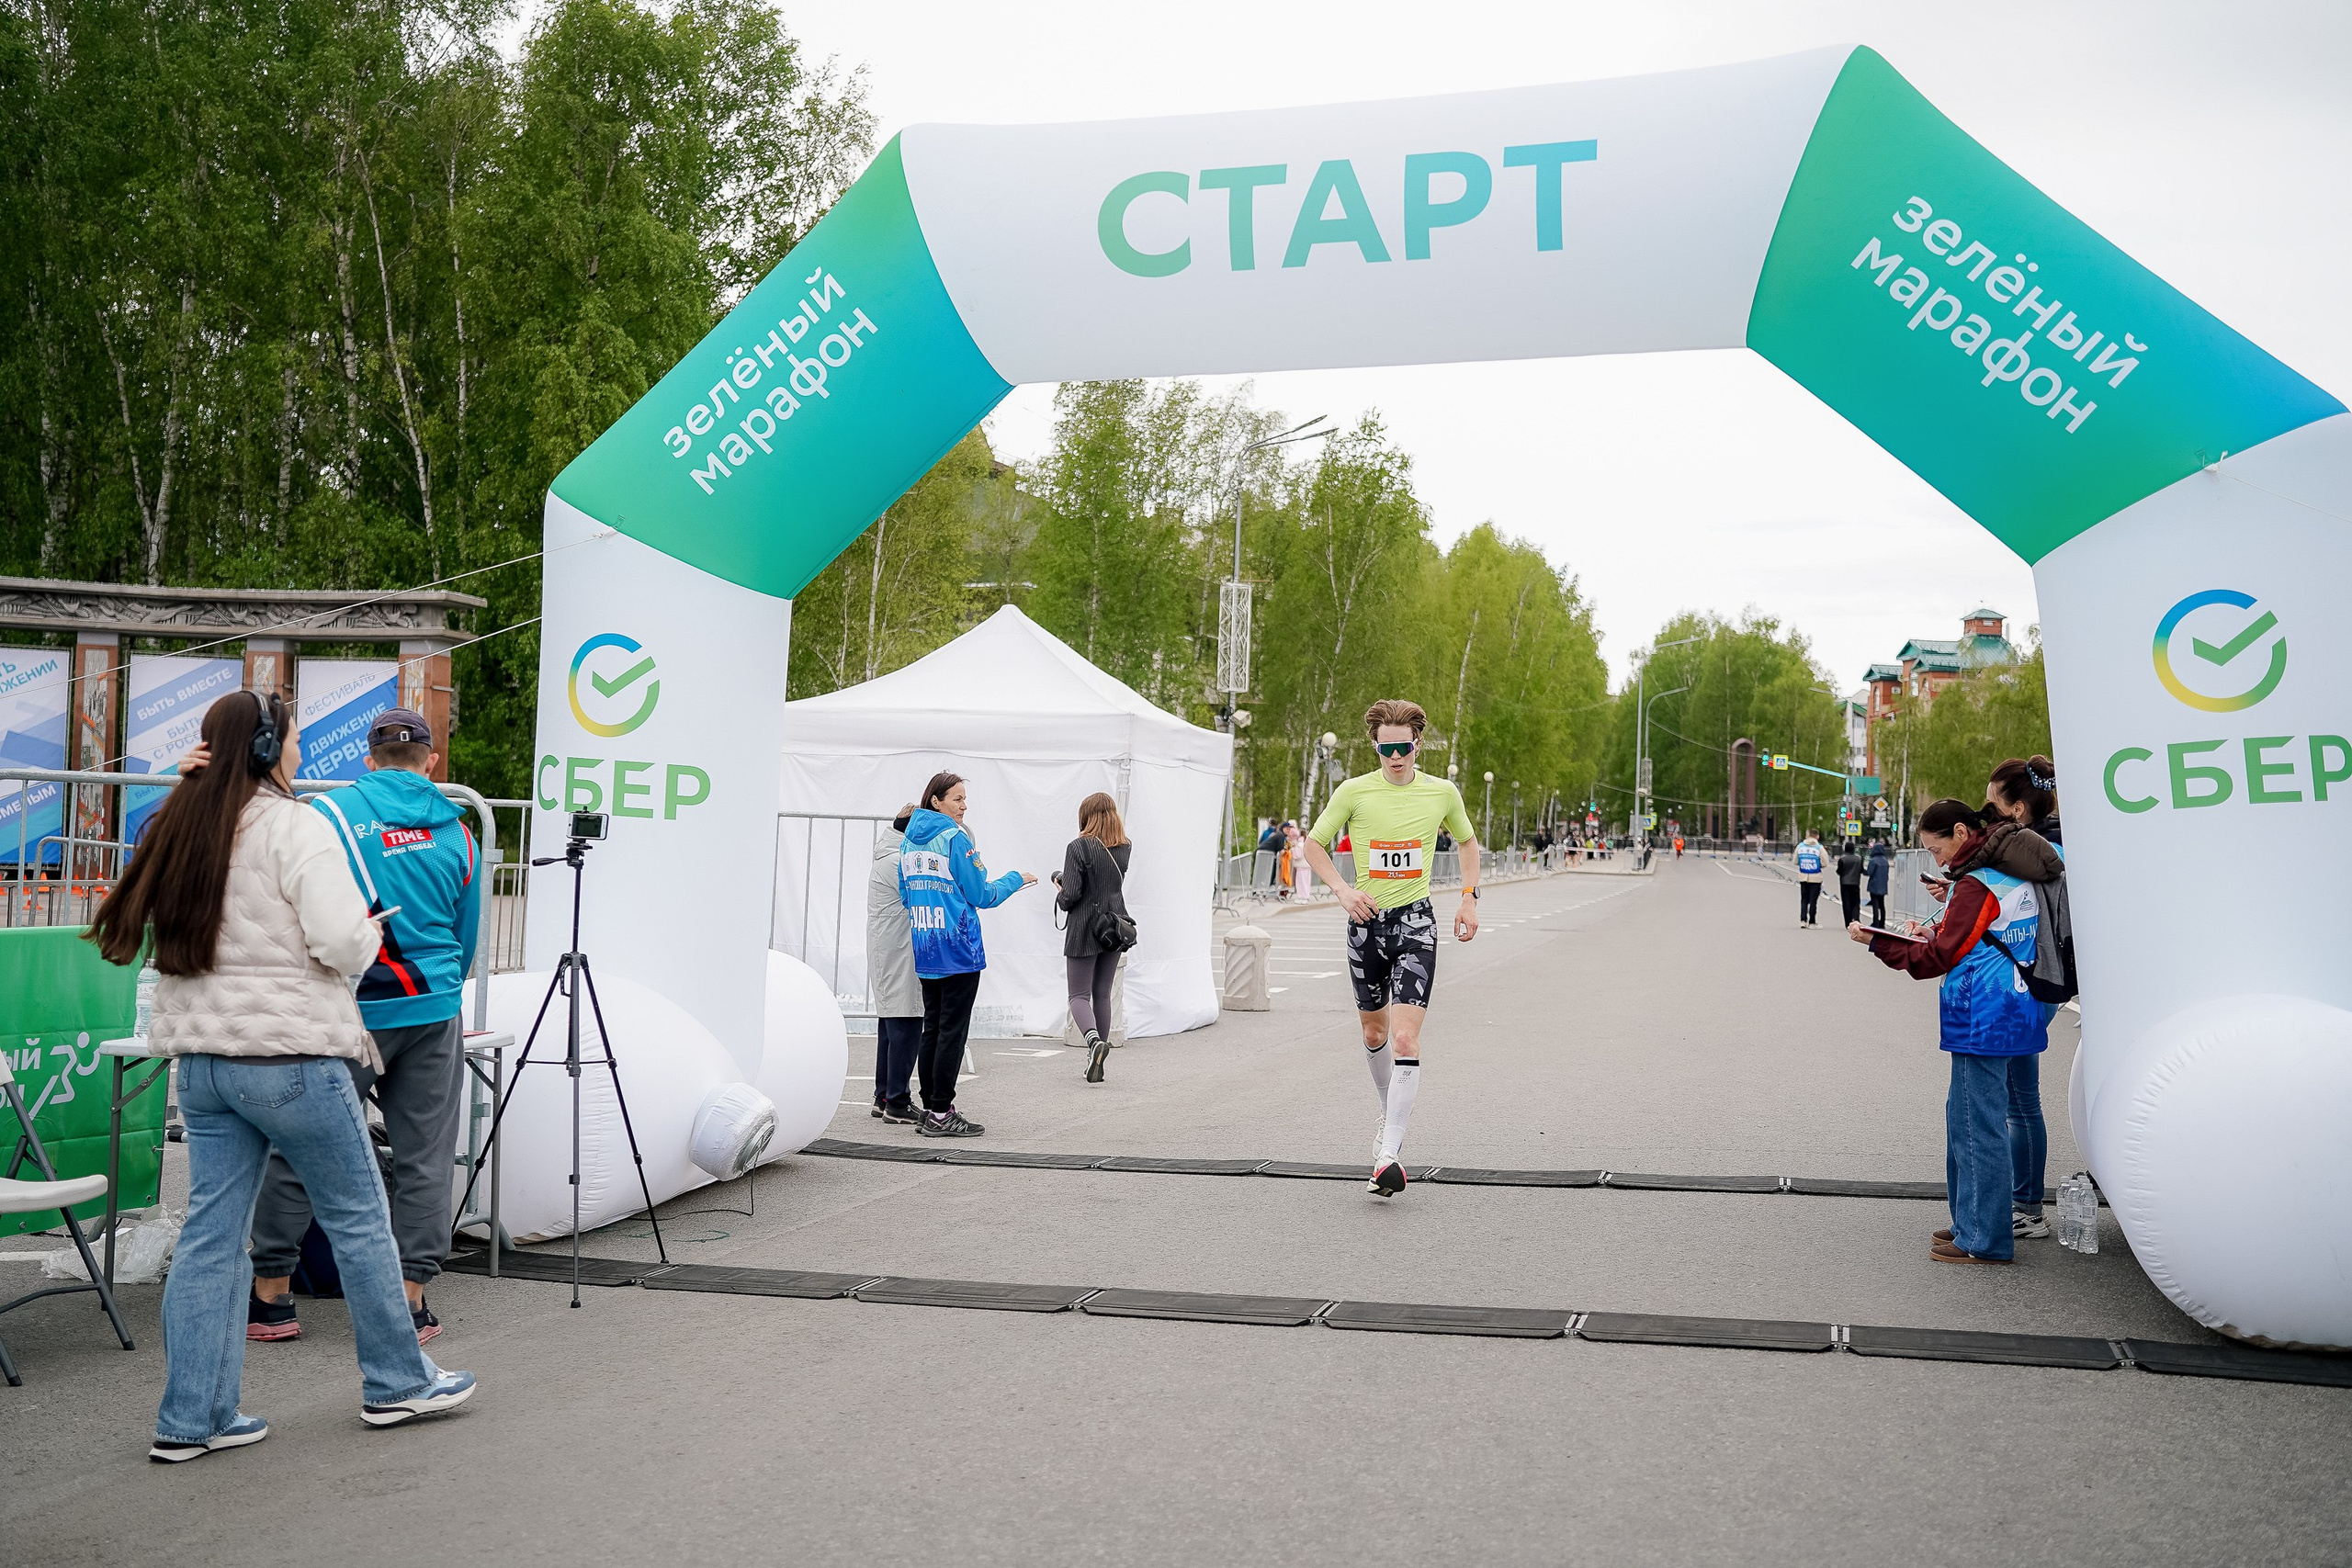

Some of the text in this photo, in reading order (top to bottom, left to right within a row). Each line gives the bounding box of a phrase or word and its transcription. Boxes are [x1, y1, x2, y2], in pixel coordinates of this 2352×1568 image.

[1097, 139, 1598, 277] СТАРТ
[1892, 196, 2148, 389] зелёный
[662, 266, 846, 458] зелёный
[1850, 236, 2098, 434] марафон
[689, 307, 878, 495] марафон
[137, 667, 232, 721] БЫТЬ ВМЕСТЕ
[304, 672, 376, 716] ФЕСТИВАЛЬ
[308, 702, 386, 759] ДВИЖЕНИЕ
[537, 754, 710, 820] СБЕР
[2103, 735, 2352, 814] СБЕР
[388, 829, 425, 845] TIME
[1381, 852, 1410, 867] 101
